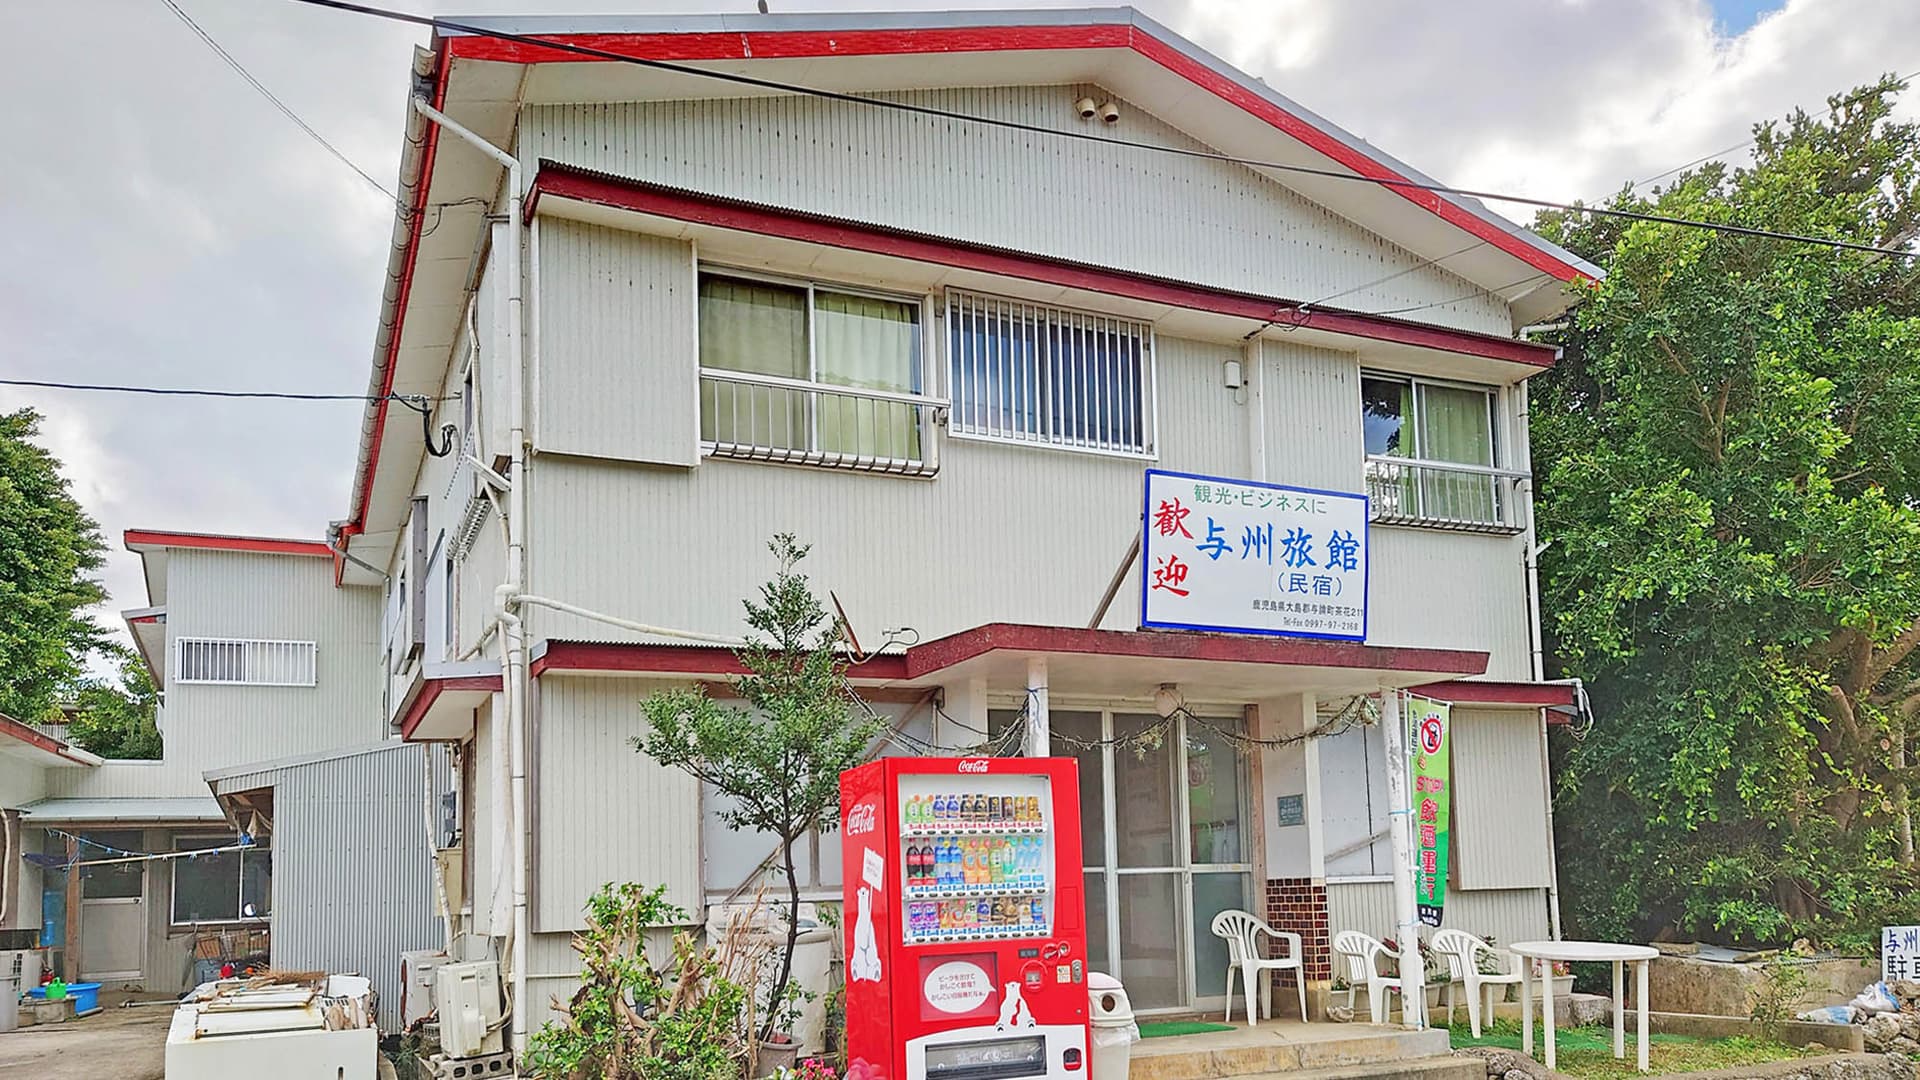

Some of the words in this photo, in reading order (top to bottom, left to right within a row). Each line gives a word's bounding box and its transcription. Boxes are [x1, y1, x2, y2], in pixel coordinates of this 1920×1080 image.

[1152, 497, 1194, 598] 歓迎
[1195, 517, 1361, 573] 与州旅館
[1885, 928, 1919, 953] 与州
